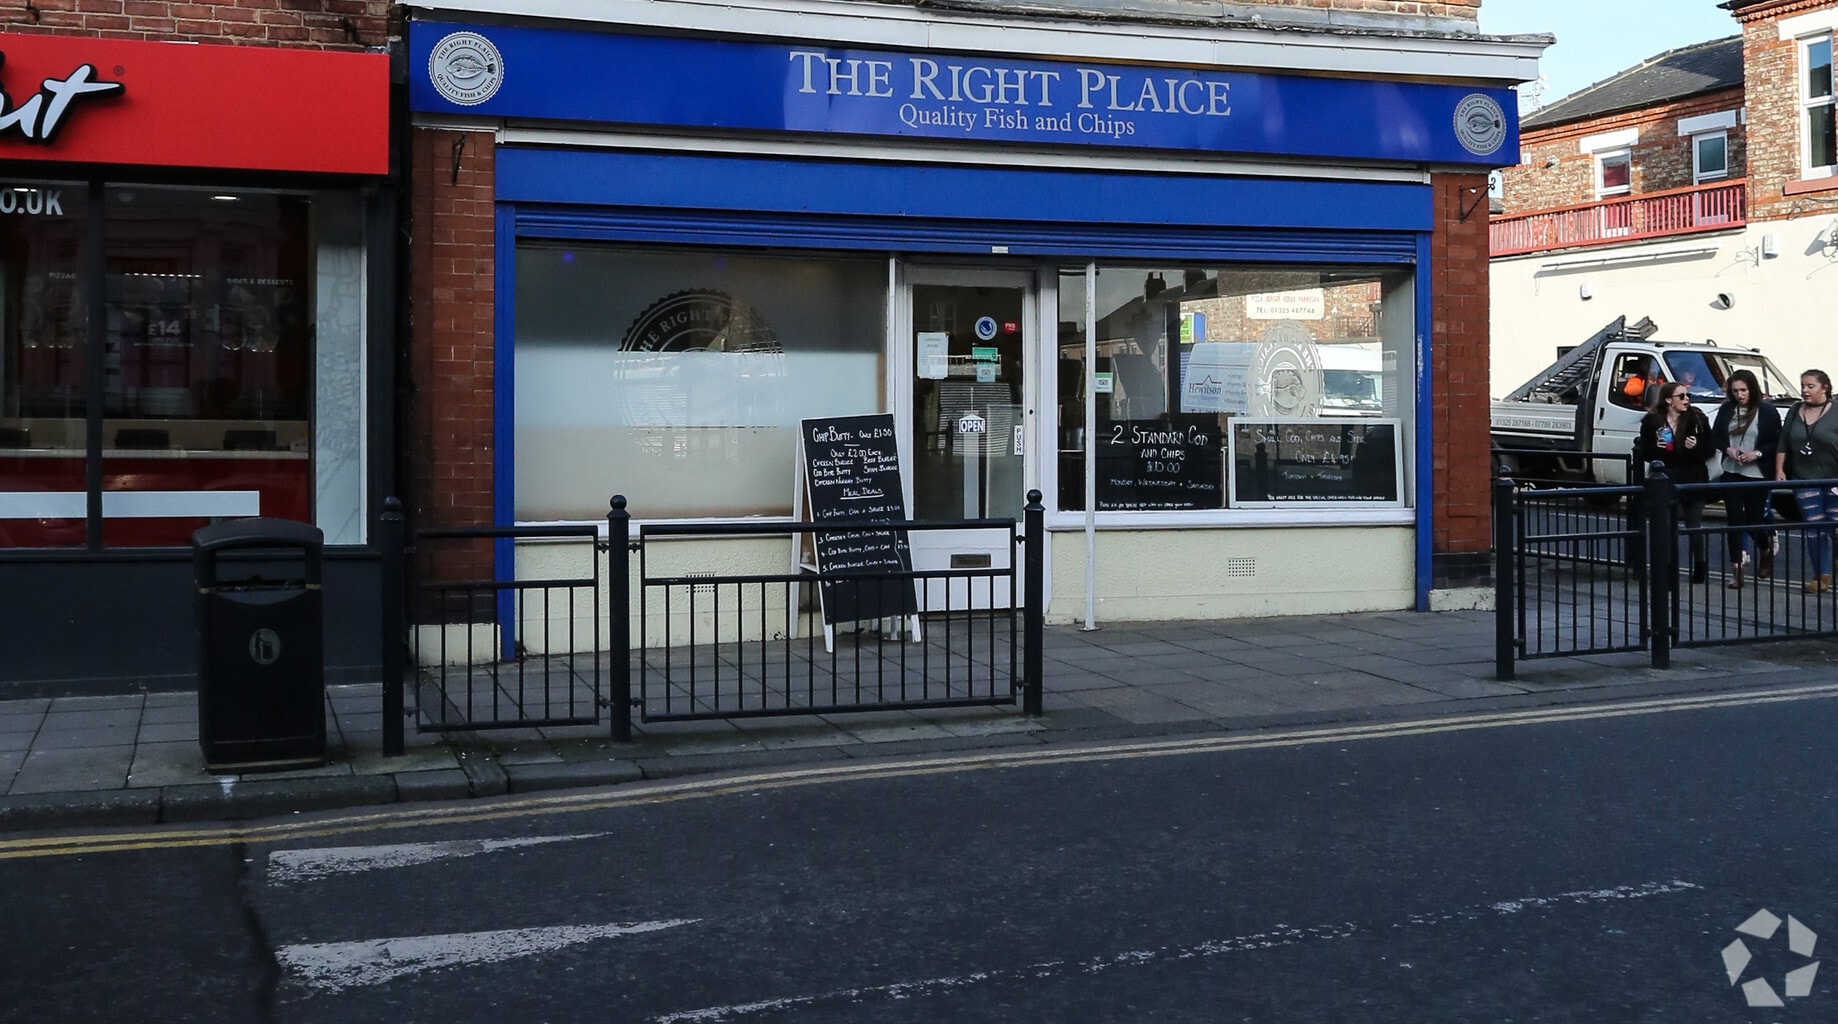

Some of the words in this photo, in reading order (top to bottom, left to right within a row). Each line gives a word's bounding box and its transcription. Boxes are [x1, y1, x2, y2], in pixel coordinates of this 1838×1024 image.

[438, 47, 449, 59] THE
[449, 39, 472, 49] RIGHT
[473, 40, 494, 62] PLAICE
[437, 73, 460, 96] QUALITY
[481, 77, 496, 93] CHIPS
[790, 51, 893, 98] THE
[910, 57, 1060, 108] RIGHT
[1077, 68, 1232, 117] PLAICE
[899, 103, 977, 132] Quality
[984, 107, 1028, 130] Fish
[1035, 112, 1072, 133] and
[1078, 113, 1135, 139] Chips
[148, 319, 181, 336] £14
[639, 330, 660, 352] HE
[659, 309, 713, 334] RIGHT
[813, 427, 829, 442] CHIP
[961, 420, 984, 432] OPEN
[1111, 424, 1125, 445] 2
[1131, 425, 1185, 444] STANDARD
[1188, 425, 1209, 446] COD
[1140, 448, 1158, 459] AND
[1160, 447, 1186, 461] CHIPS
[1295, 450, 1316, 463] ONLY
[836, 468, 851, 476] BUTTY
[843, 487, 860, 497] MEAL
[862, 486, 882, 495] DEALS
